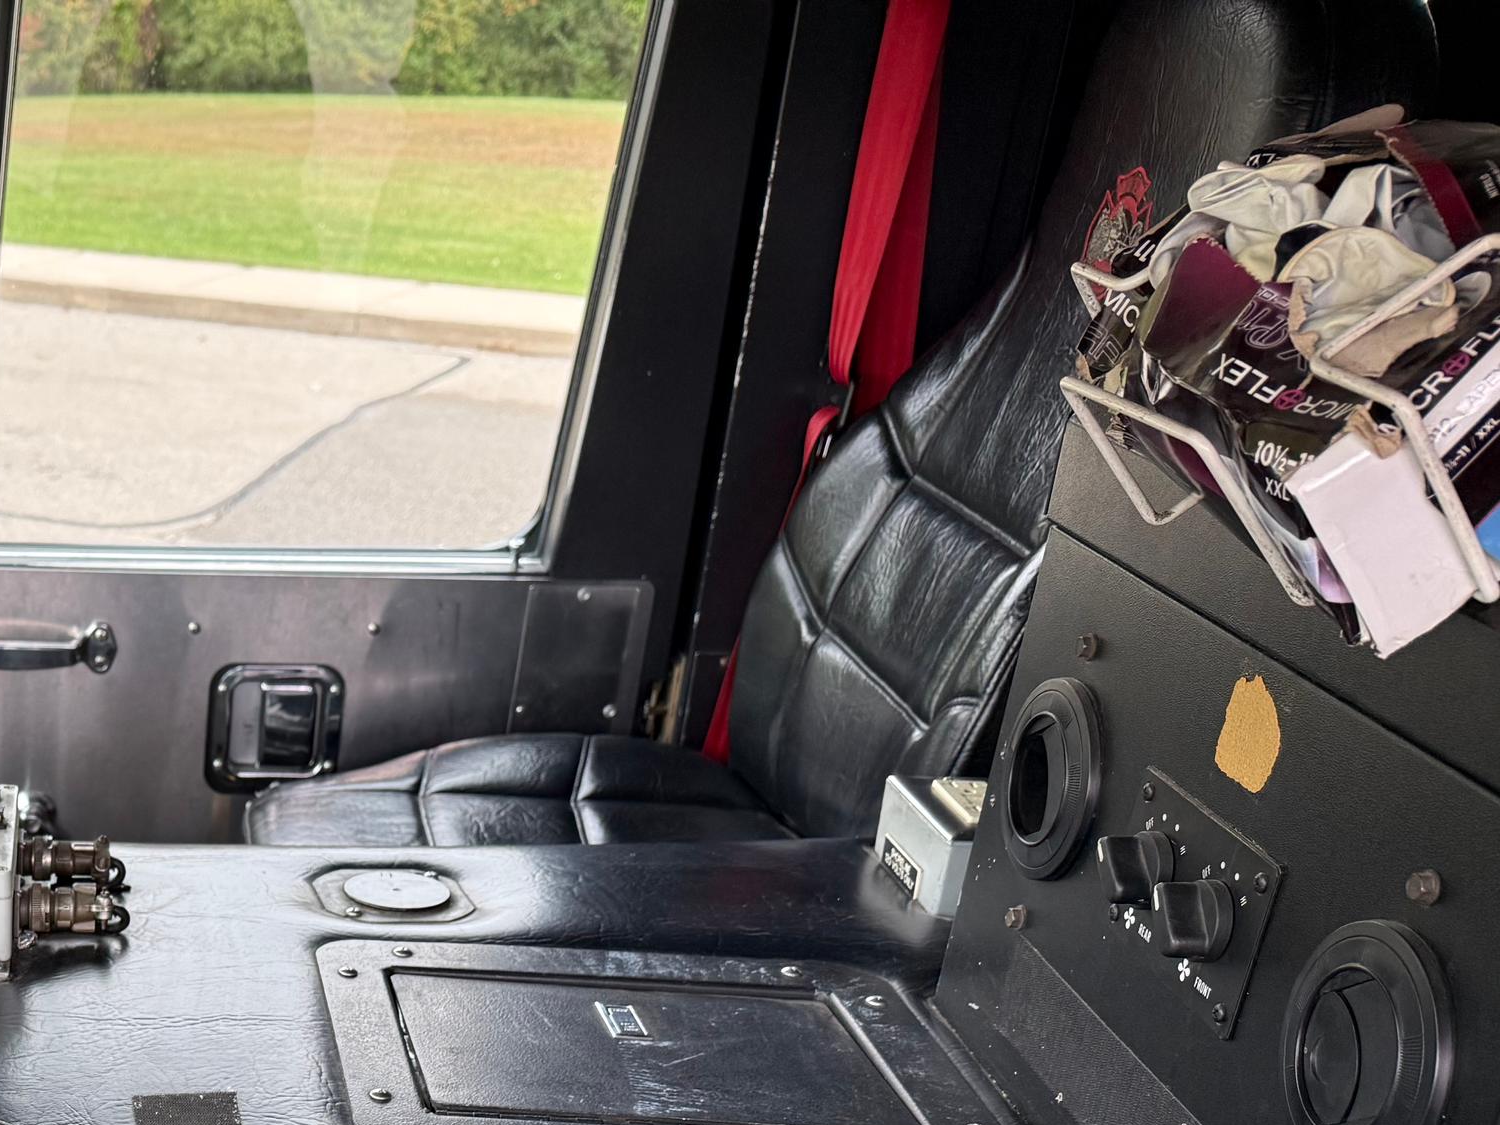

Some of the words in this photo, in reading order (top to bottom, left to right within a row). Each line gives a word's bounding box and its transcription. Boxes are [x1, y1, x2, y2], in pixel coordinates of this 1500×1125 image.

[1103, 288, 1140, 332] MIC
[1408, 315, 1500, 411] CROFL
[1137, 922, 1152, 944] REAR
[1193, 975, 1213, 1000] FRONT
